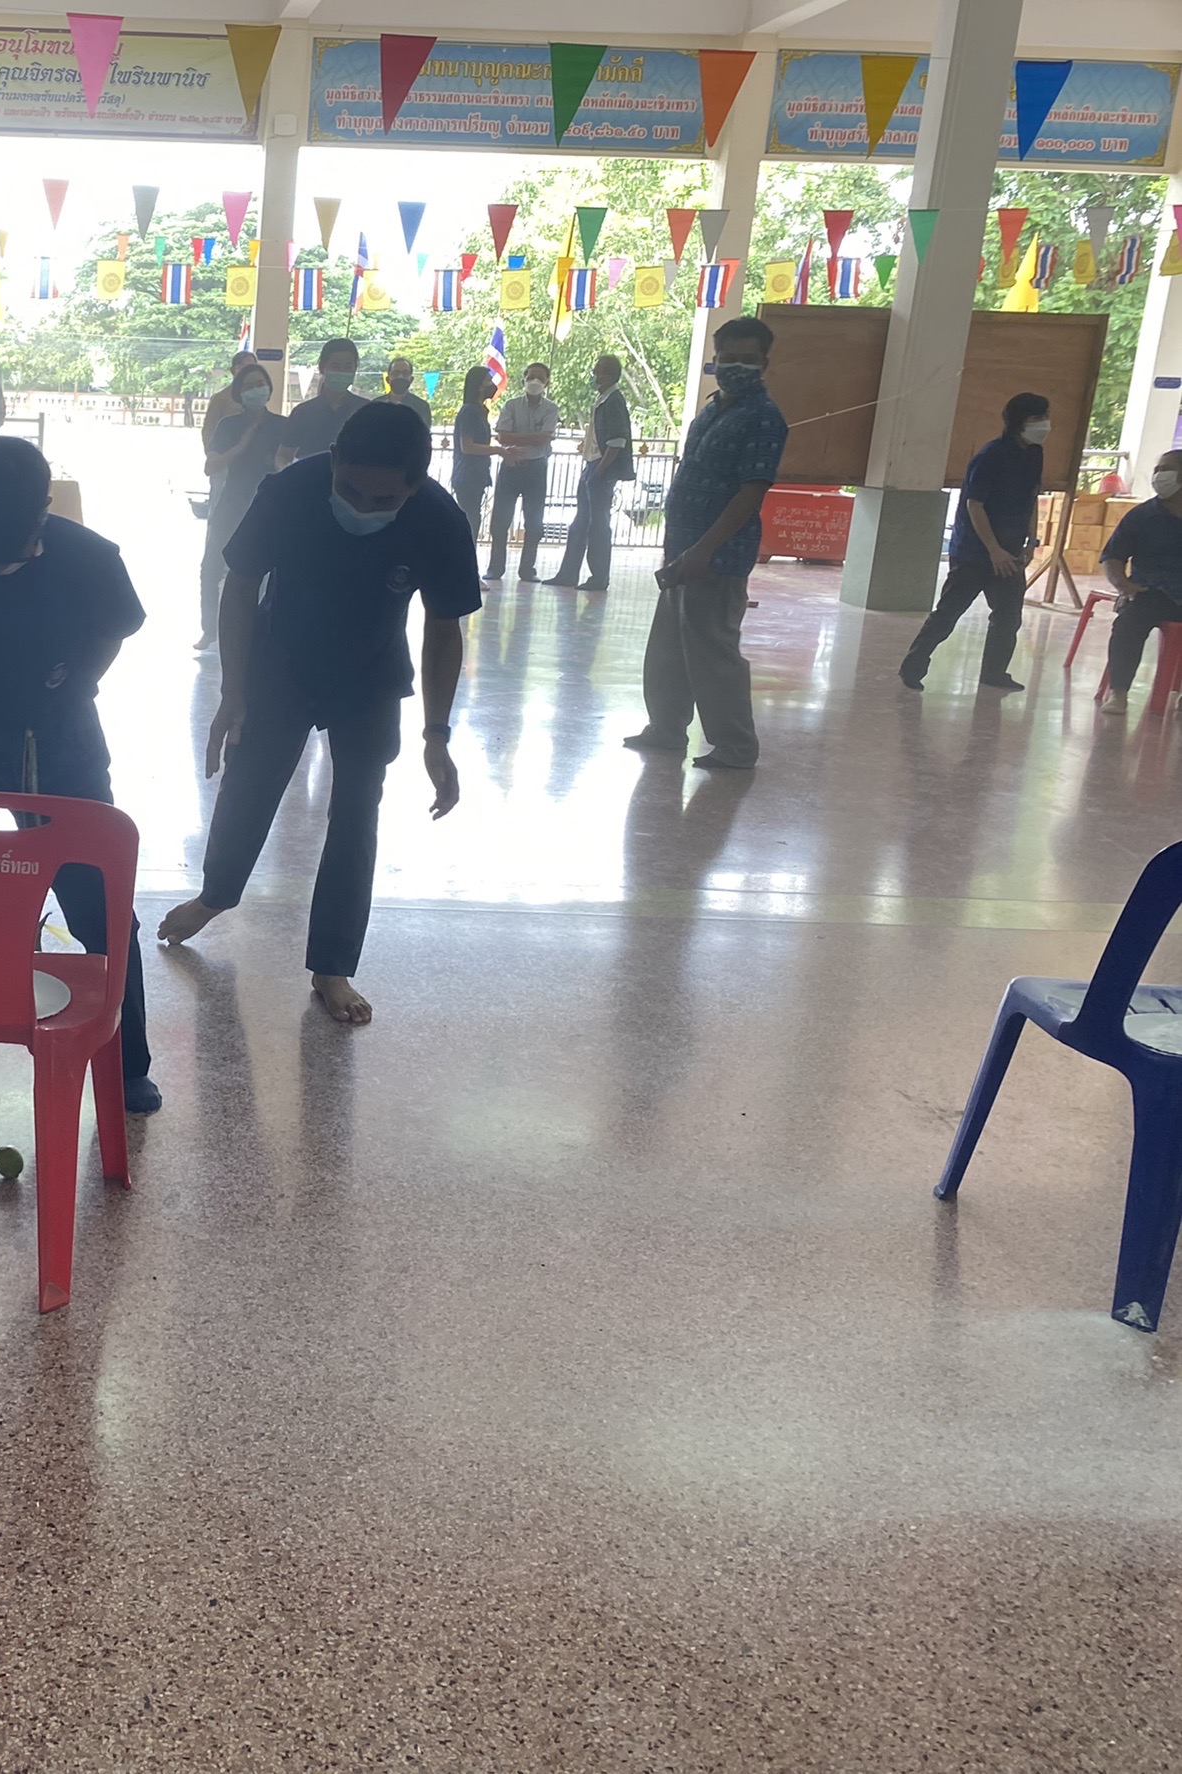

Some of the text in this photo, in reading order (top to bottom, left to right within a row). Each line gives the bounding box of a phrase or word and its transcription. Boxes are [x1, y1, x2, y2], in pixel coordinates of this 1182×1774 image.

[506, 115, 550, 135] จำนวน
[652, 125, 680, 140] บาท
[1100, 138, 1130, 153] บาท
